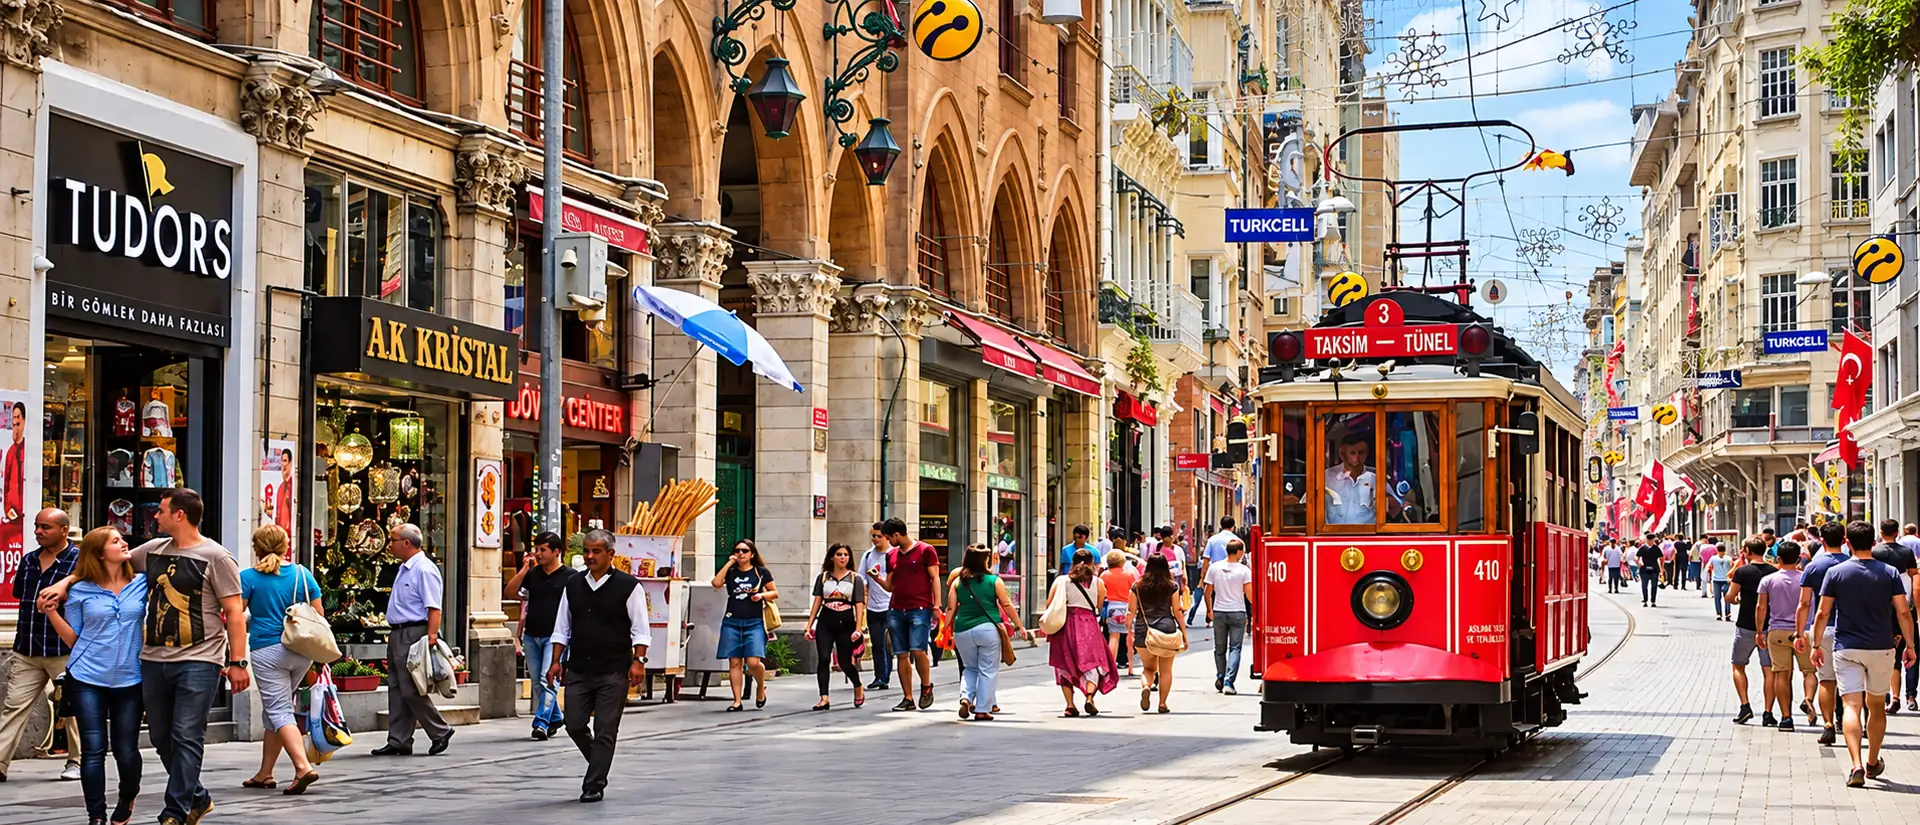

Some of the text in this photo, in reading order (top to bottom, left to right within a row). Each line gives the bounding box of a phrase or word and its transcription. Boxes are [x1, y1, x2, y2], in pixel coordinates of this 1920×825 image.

[66, 178, 231, 279] TUDORS
[1230, 218, 1309, 233] TURKCELL
[52, 291, 226, 338] BİR GÖMLEK DAHA FAZLASI
[1378, 303, 1390, 324] 3
[1314, 330, 1368, 355] TAKSİM
[1404, 329, 1453, 352] TÜNEL
[1767, 336, 1825, 349] TURKCELL
[415, 325, 513, 384] KRİSTAL
[1267, 561, 1287, 582] 410
[1474, 560, 1500, 580] 410
